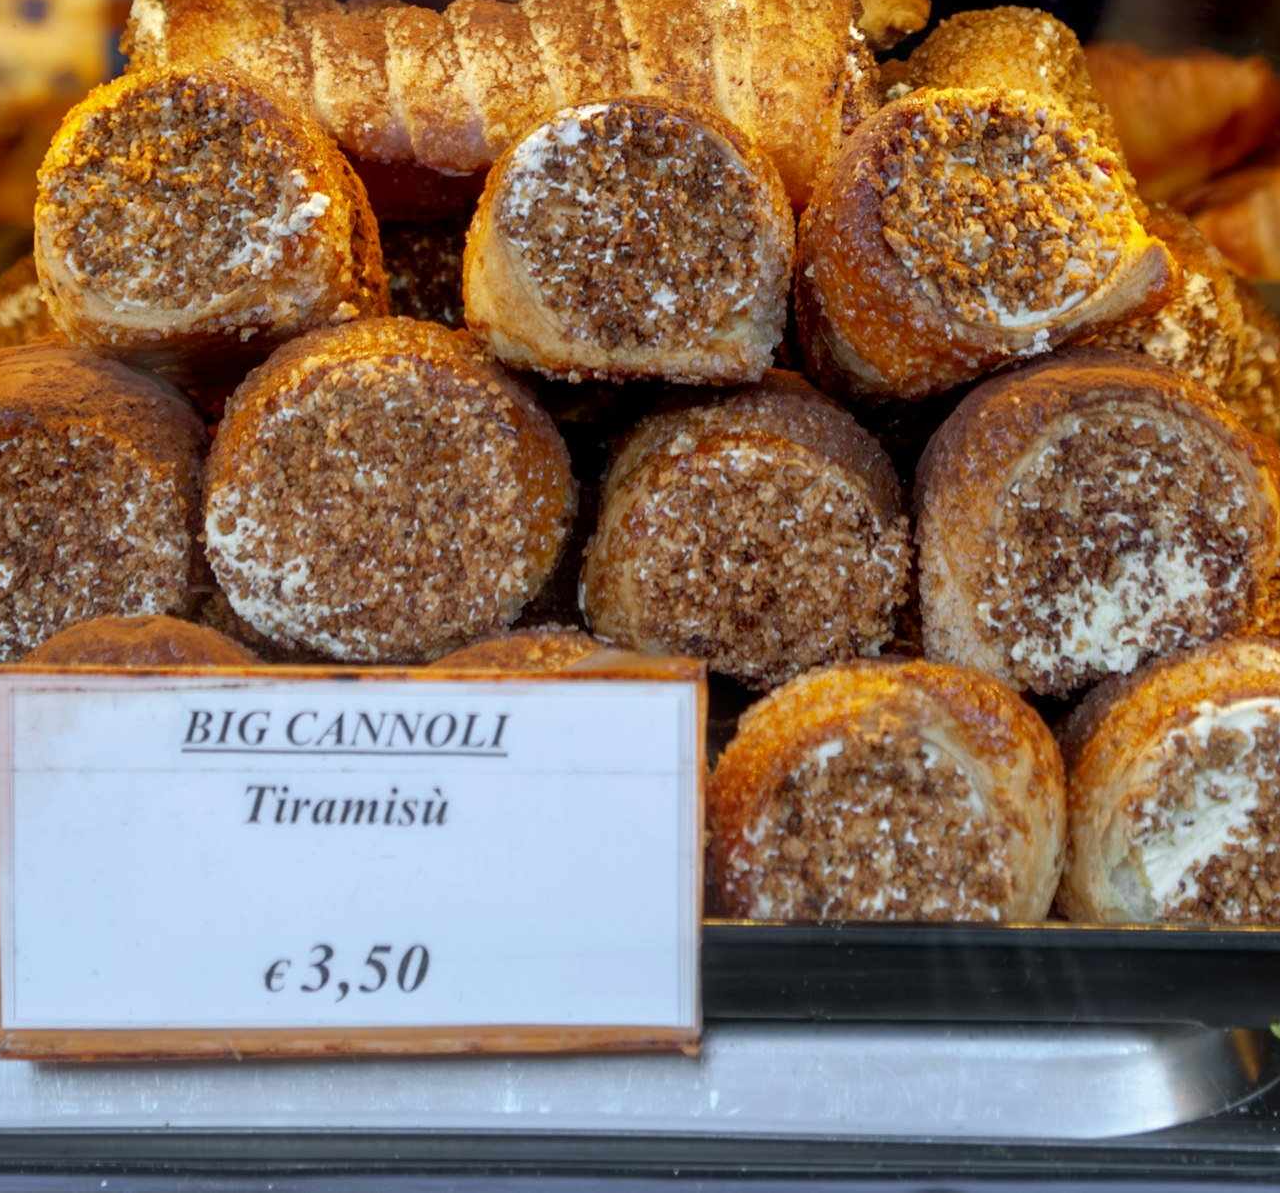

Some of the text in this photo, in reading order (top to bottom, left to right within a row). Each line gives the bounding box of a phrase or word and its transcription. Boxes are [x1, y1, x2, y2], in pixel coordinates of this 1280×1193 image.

[181, 709, 510, 748] BIG CANNOLI
[244, 784, 449, 827] Tiramisù
